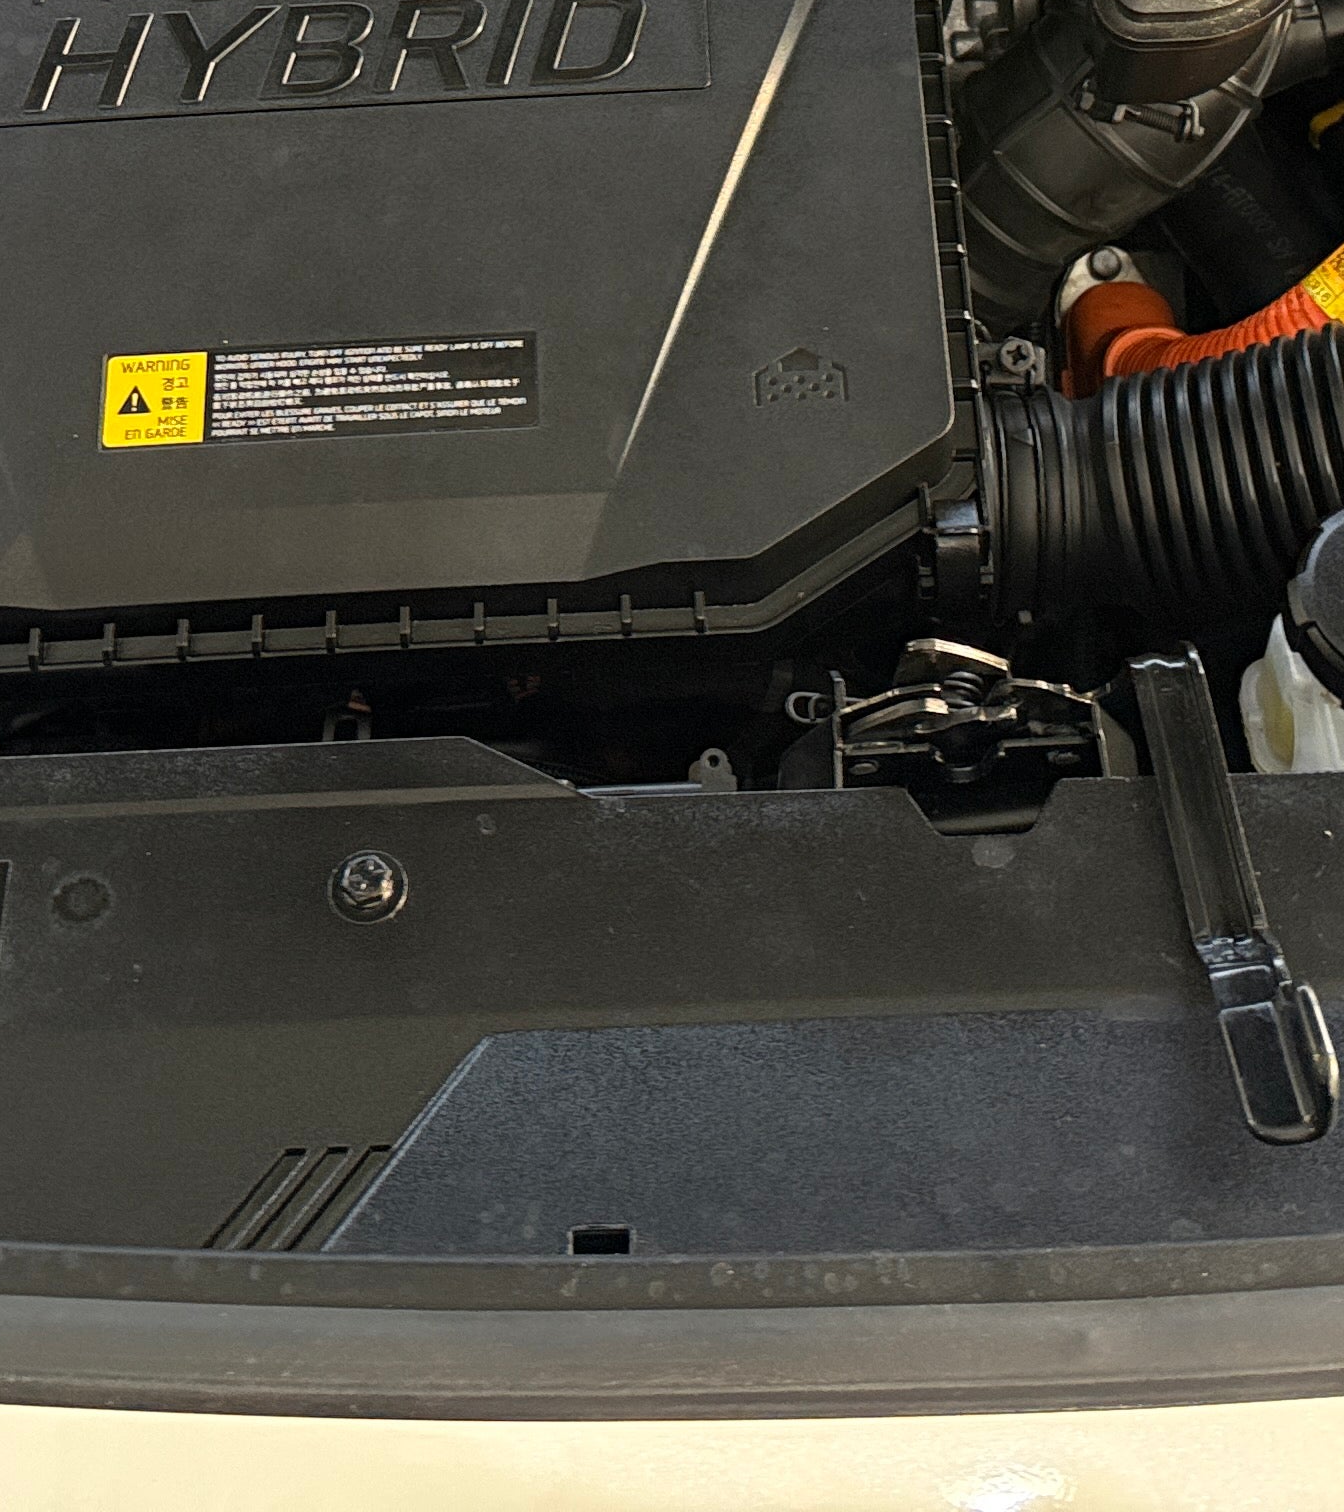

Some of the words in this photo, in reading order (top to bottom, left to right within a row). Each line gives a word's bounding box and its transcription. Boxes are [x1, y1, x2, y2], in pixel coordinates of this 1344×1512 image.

[121, 358, 191, 374] WARNING
[161, 376, 190, 392] 경고
[157, 415, 189, 427] MISE
[124, 428, 141, 441] EN
[145, 426, 187, 439] GARDE
